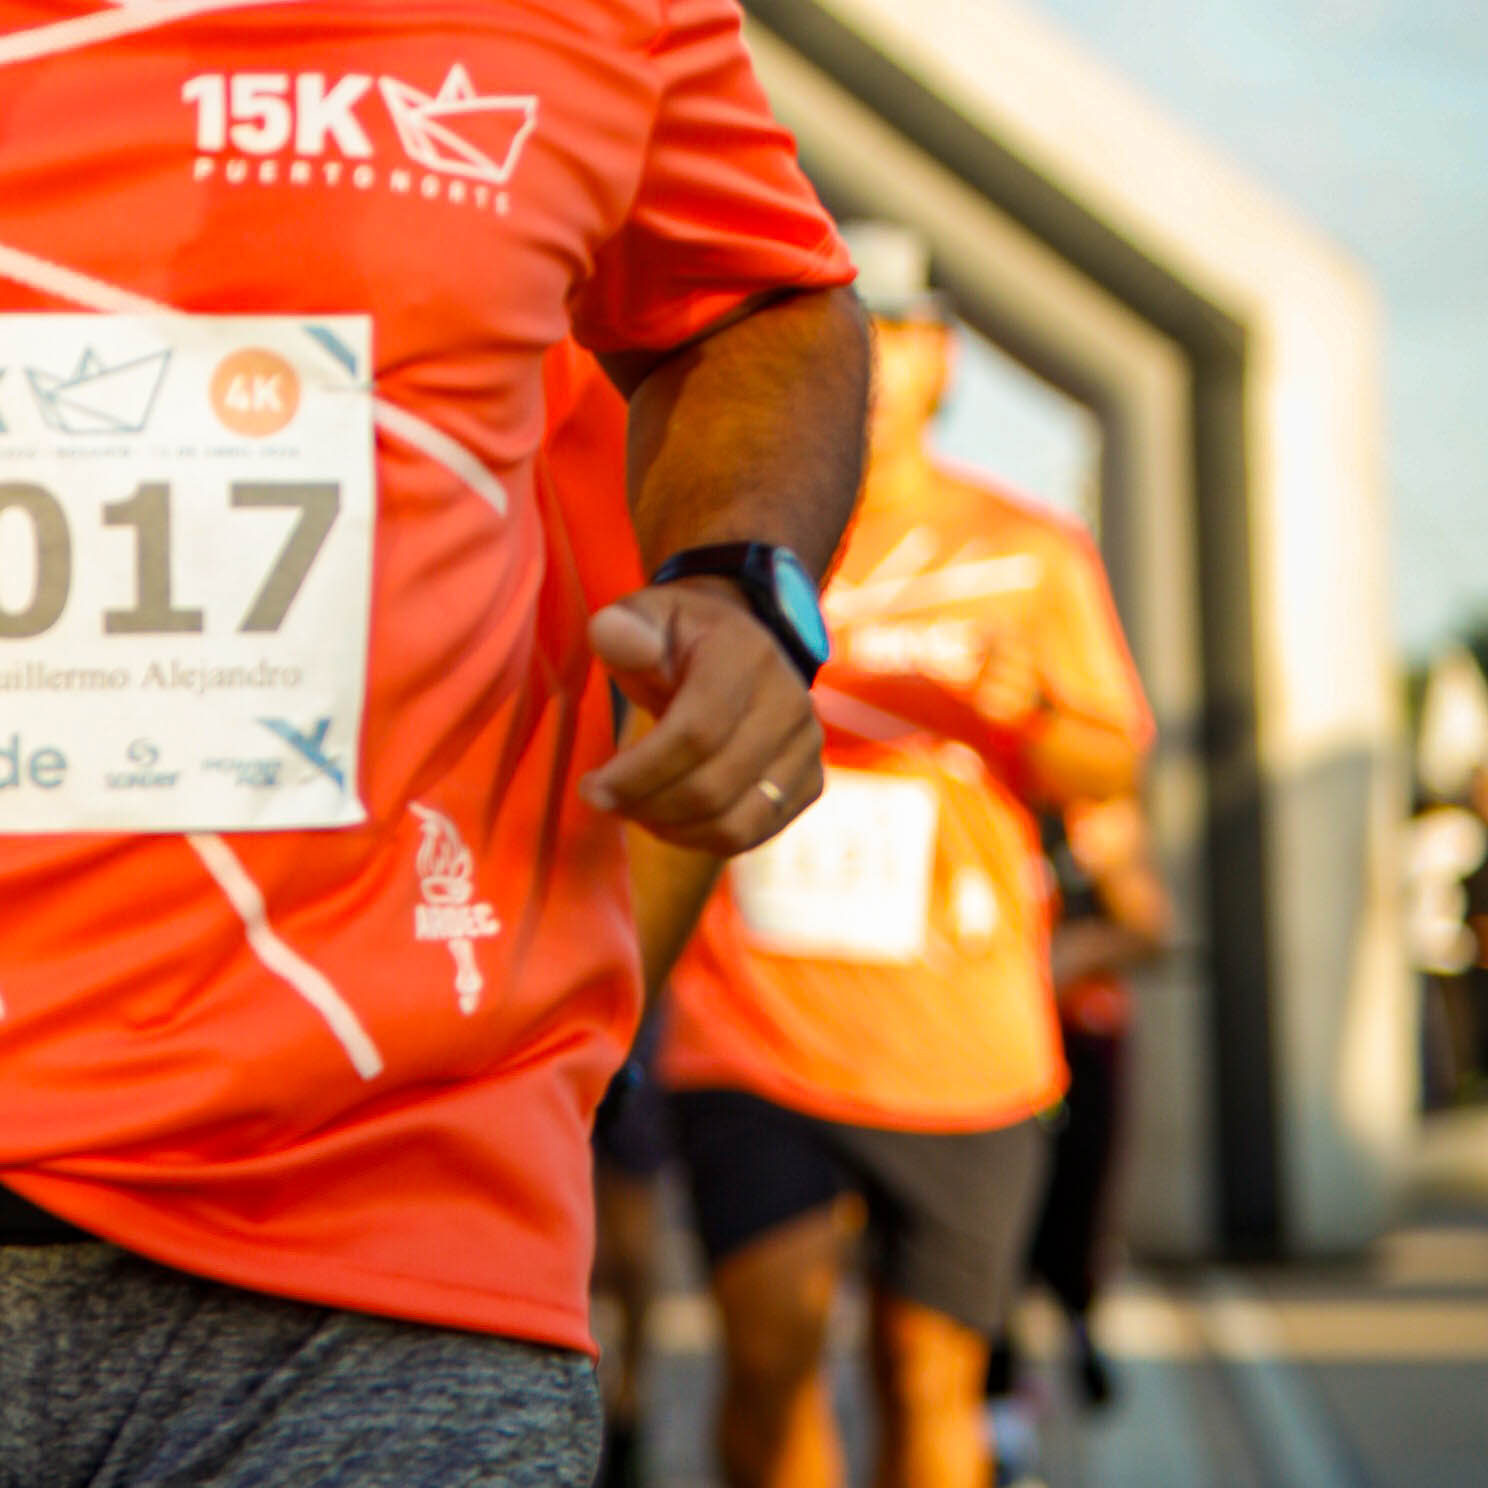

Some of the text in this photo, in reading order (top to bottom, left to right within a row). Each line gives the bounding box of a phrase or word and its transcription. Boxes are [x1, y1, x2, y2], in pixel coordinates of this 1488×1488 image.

[181, 72, 374, 159] 15K
[192, 155, 512, 217] PUERTO NORTE
[223, 373, 285, 412] 4K
[139, 656, 304, 697] Alejandro
